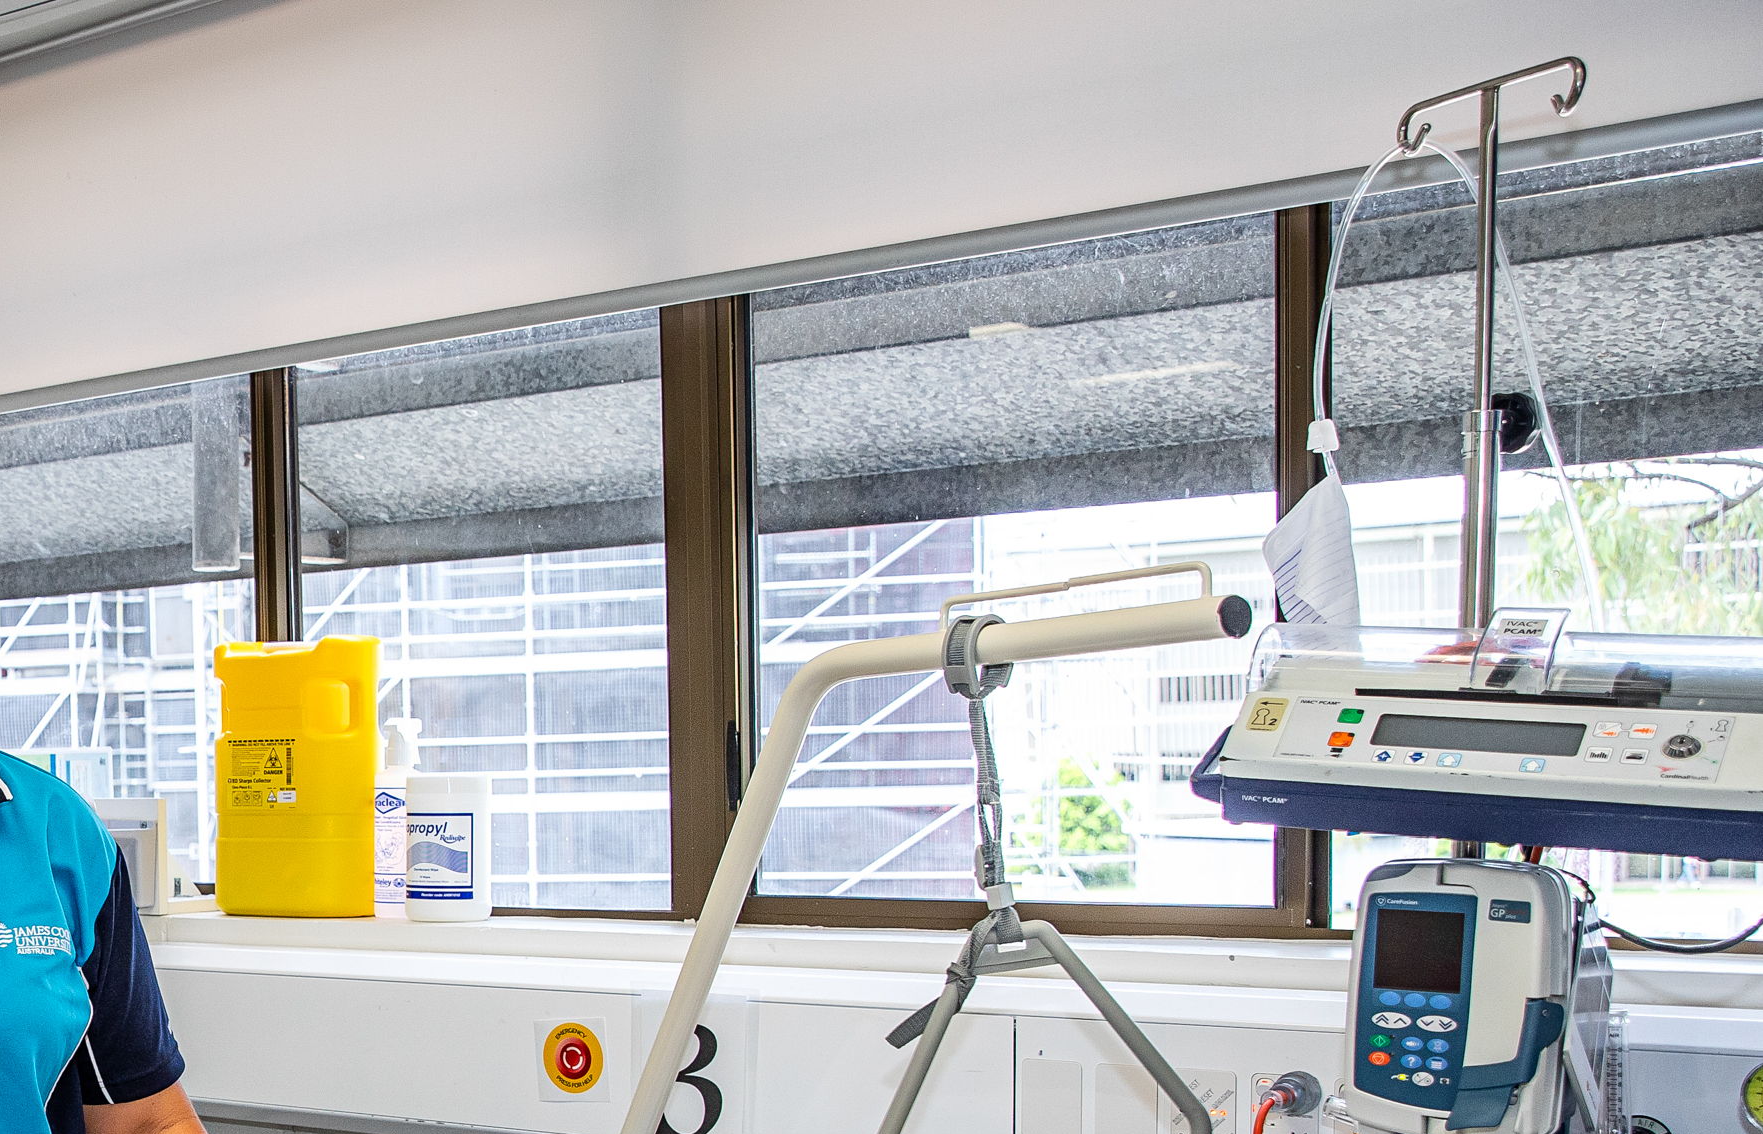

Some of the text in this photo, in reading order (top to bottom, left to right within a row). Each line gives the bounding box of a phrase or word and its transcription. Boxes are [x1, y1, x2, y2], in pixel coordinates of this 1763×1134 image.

[1268, 718, 1278, 726] 2
[1490, 908, 1506, 918] GP
[13, 925, 50, 937] JAMES
[555, 1028, 587, 1040] EMERGENCY
[556, 1075, 571, 1087] PRESS
[582, 1074, 594, 1086] HELP
[1188, 1079, 1200, 1091] EST
[1637, 1119, 1654, 1129] AIR
